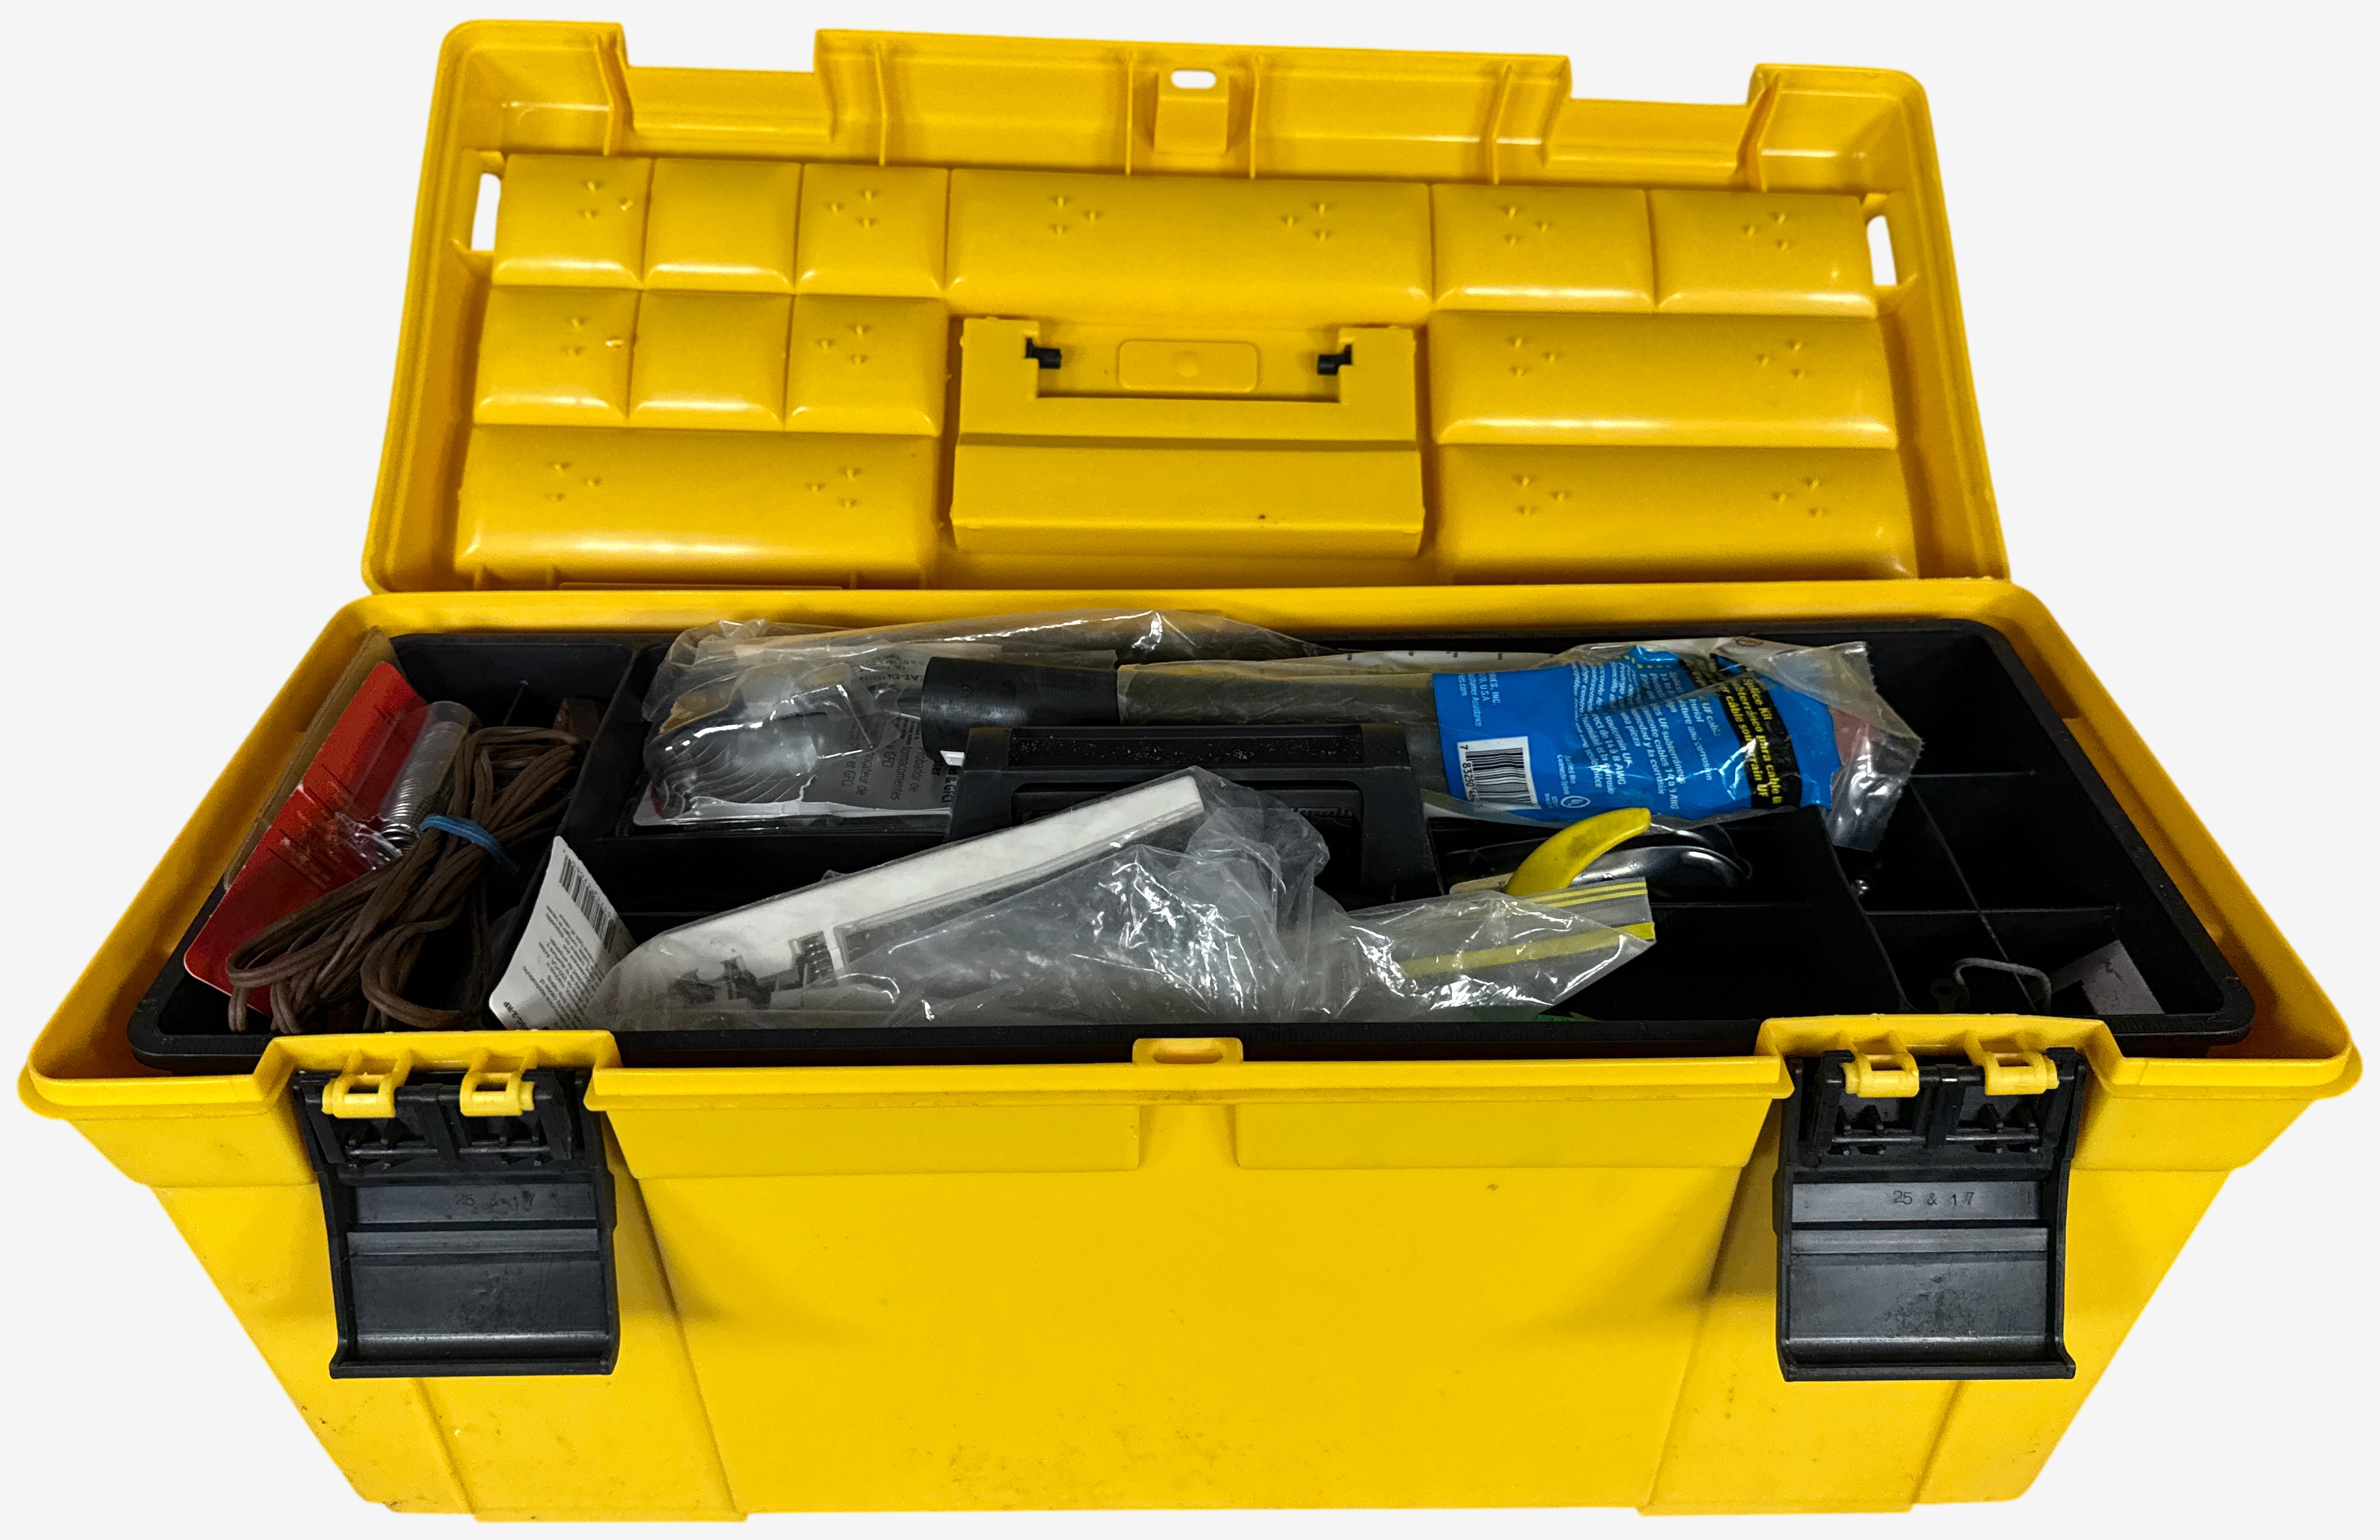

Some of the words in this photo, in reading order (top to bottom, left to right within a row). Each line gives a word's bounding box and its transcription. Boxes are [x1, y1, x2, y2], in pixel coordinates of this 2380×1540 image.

[1701, 702, 1713, 714] UF
[1758, 707, 1773, 720] Kit
[1657, 718, 1669, 731] UF
[882, 751, 896, 769] GFCI
[1654, 739, 1669, 767] cables
[1738, 724, 1764, 781] sourrain
[1756, 784, 1769, 797] UF
[1755, 735, 1772, 762] para
[1765, 763, 1782, 794] cable
[1462, 762, 1475, 787] 83250
[1614, 763, 1626, 785] AWG
[909, 782, 922, 793] de
[941, 785, 956, 803] GFCI
[455, 1192, 475, 1207] 25
[1892, 1190, 1913, 1205] 25
[1926, 1192, 1938, 1205] &
